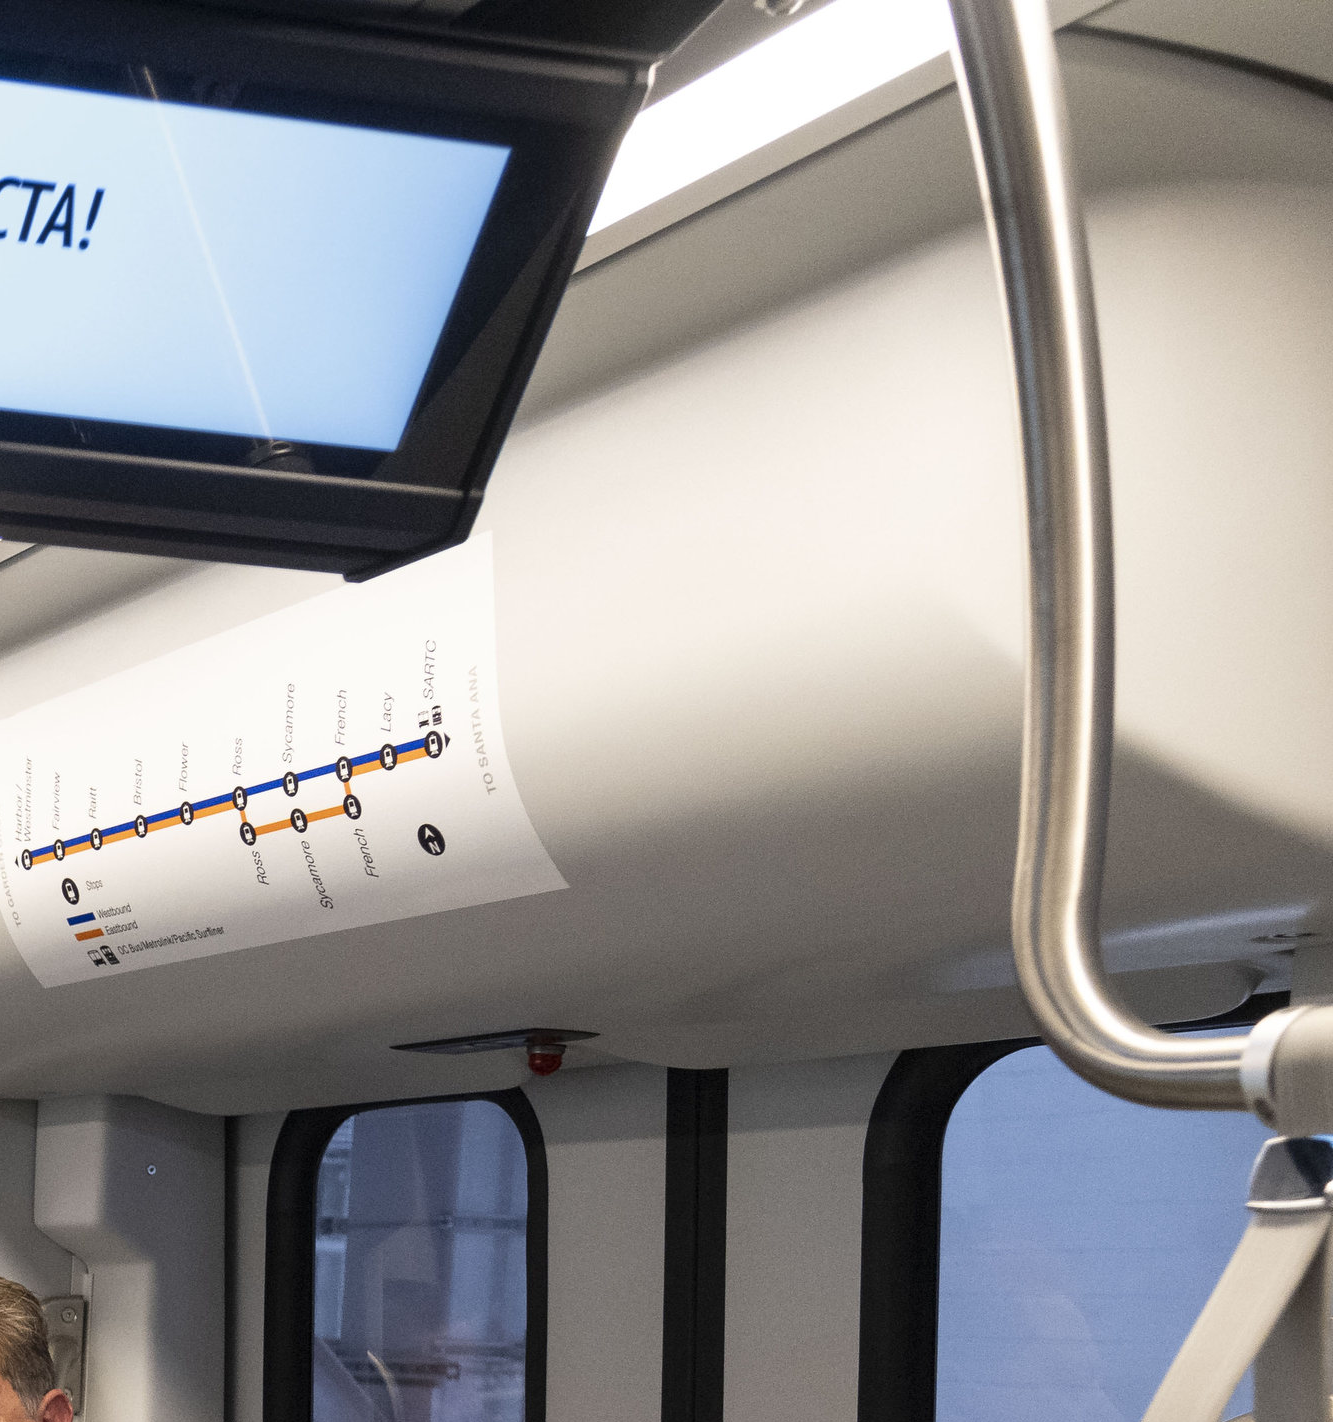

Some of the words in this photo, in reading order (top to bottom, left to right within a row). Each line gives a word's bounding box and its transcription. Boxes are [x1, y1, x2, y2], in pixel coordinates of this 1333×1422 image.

[423, 639, 436, 700] SARTC
[469, 665, 479, 702] ANA
[282, 683, 295, 764] Sycamore
[335, 689, 347, 746] French
[381, 692, 394, 732] Lacy
[233, 737, 243, 776] Ross
[471, 709, 488, 768] SANTA
[134, 758, 143, 805] Bristol
[179, 742, 189, 791] Flower
[483, 772, 496, 796] TO
[15, 794, 23, 842] Harbor
[24, 756, 33, 842] Westminster
[52, 771, 61, 830] Fairview
[89, 787, 97, 819] Raitt
[252, 850, 269, 886] Ross
[301, 840, 333, 910] Sycamore
[354, 828, 379, 878] French
[86, 879, 103, 891] Stops
[96, 903, 131, 919] Westbound
[105, 920, 139, 936] Eastbound
[118, 944, 129, 956] OC
[195, 925, 225, 940] Surfliner
